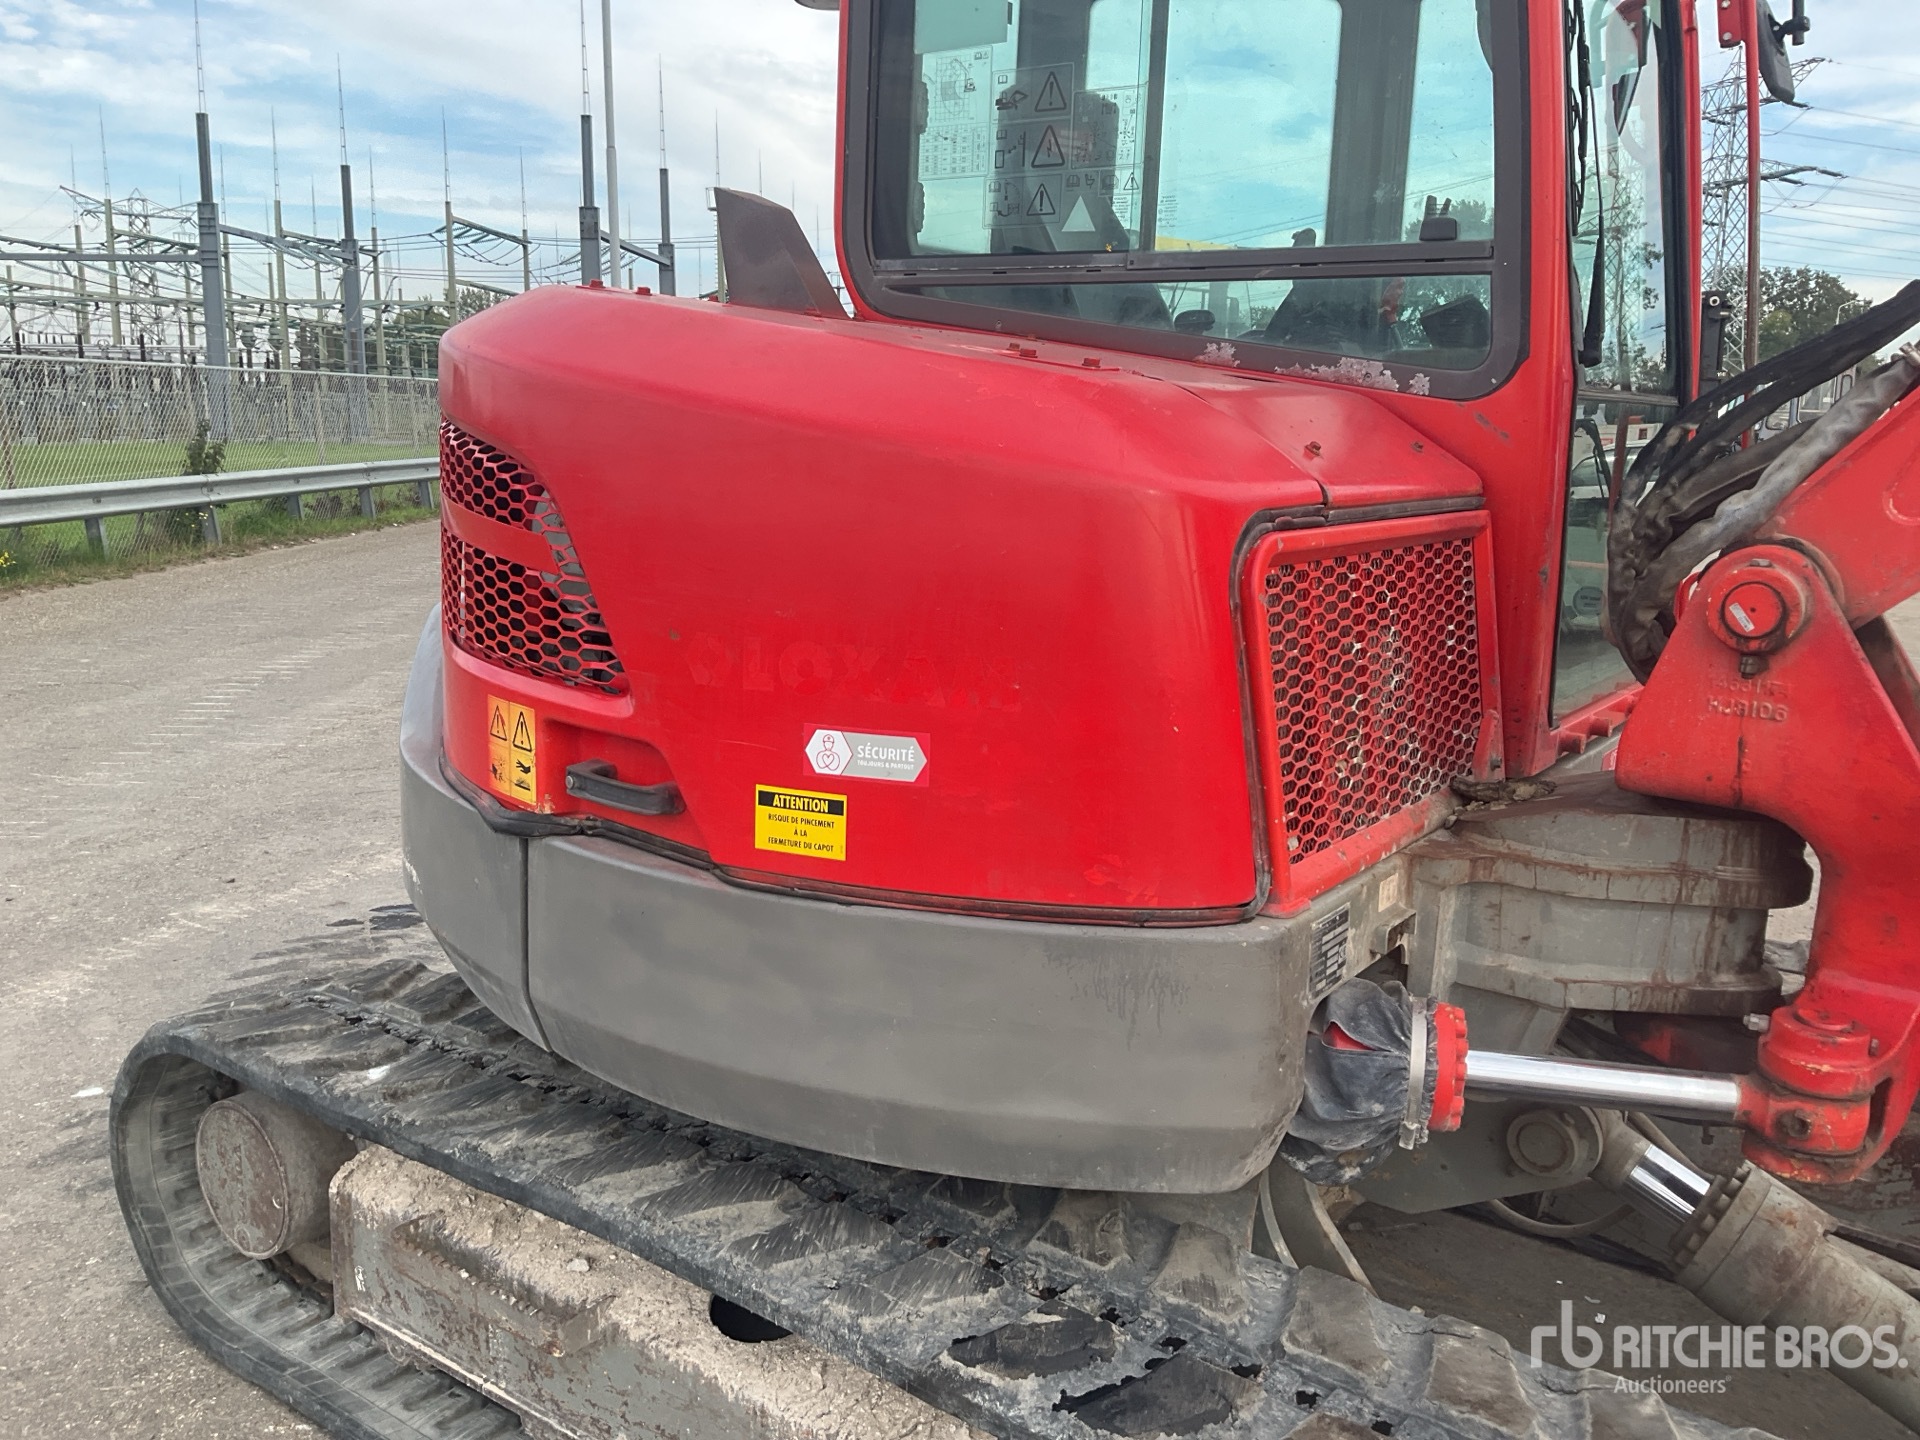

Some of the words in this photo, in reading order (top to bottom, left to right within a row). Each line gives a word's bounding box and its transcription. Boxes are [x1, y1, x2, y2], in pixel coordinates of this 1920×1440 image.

[857, 742, 915, 762] SÉCURITÉ
[857, 760, 884, 768] TOUJOURS
[890, 762, 915, 770] PARTOUT
[772, 794, 829, 813] ATTENTION
[768, 813, 789, 823] RISQUE
[791, 816, 799, 825] DE
[800, 817, 835, 829] PINCEMENT
[800, 829, 808, 837] LA
[768, 836, 802, 848] FERMETURE
[803, 841, 812, 850] DU
[813, 843, 834, 853] CAPOT
